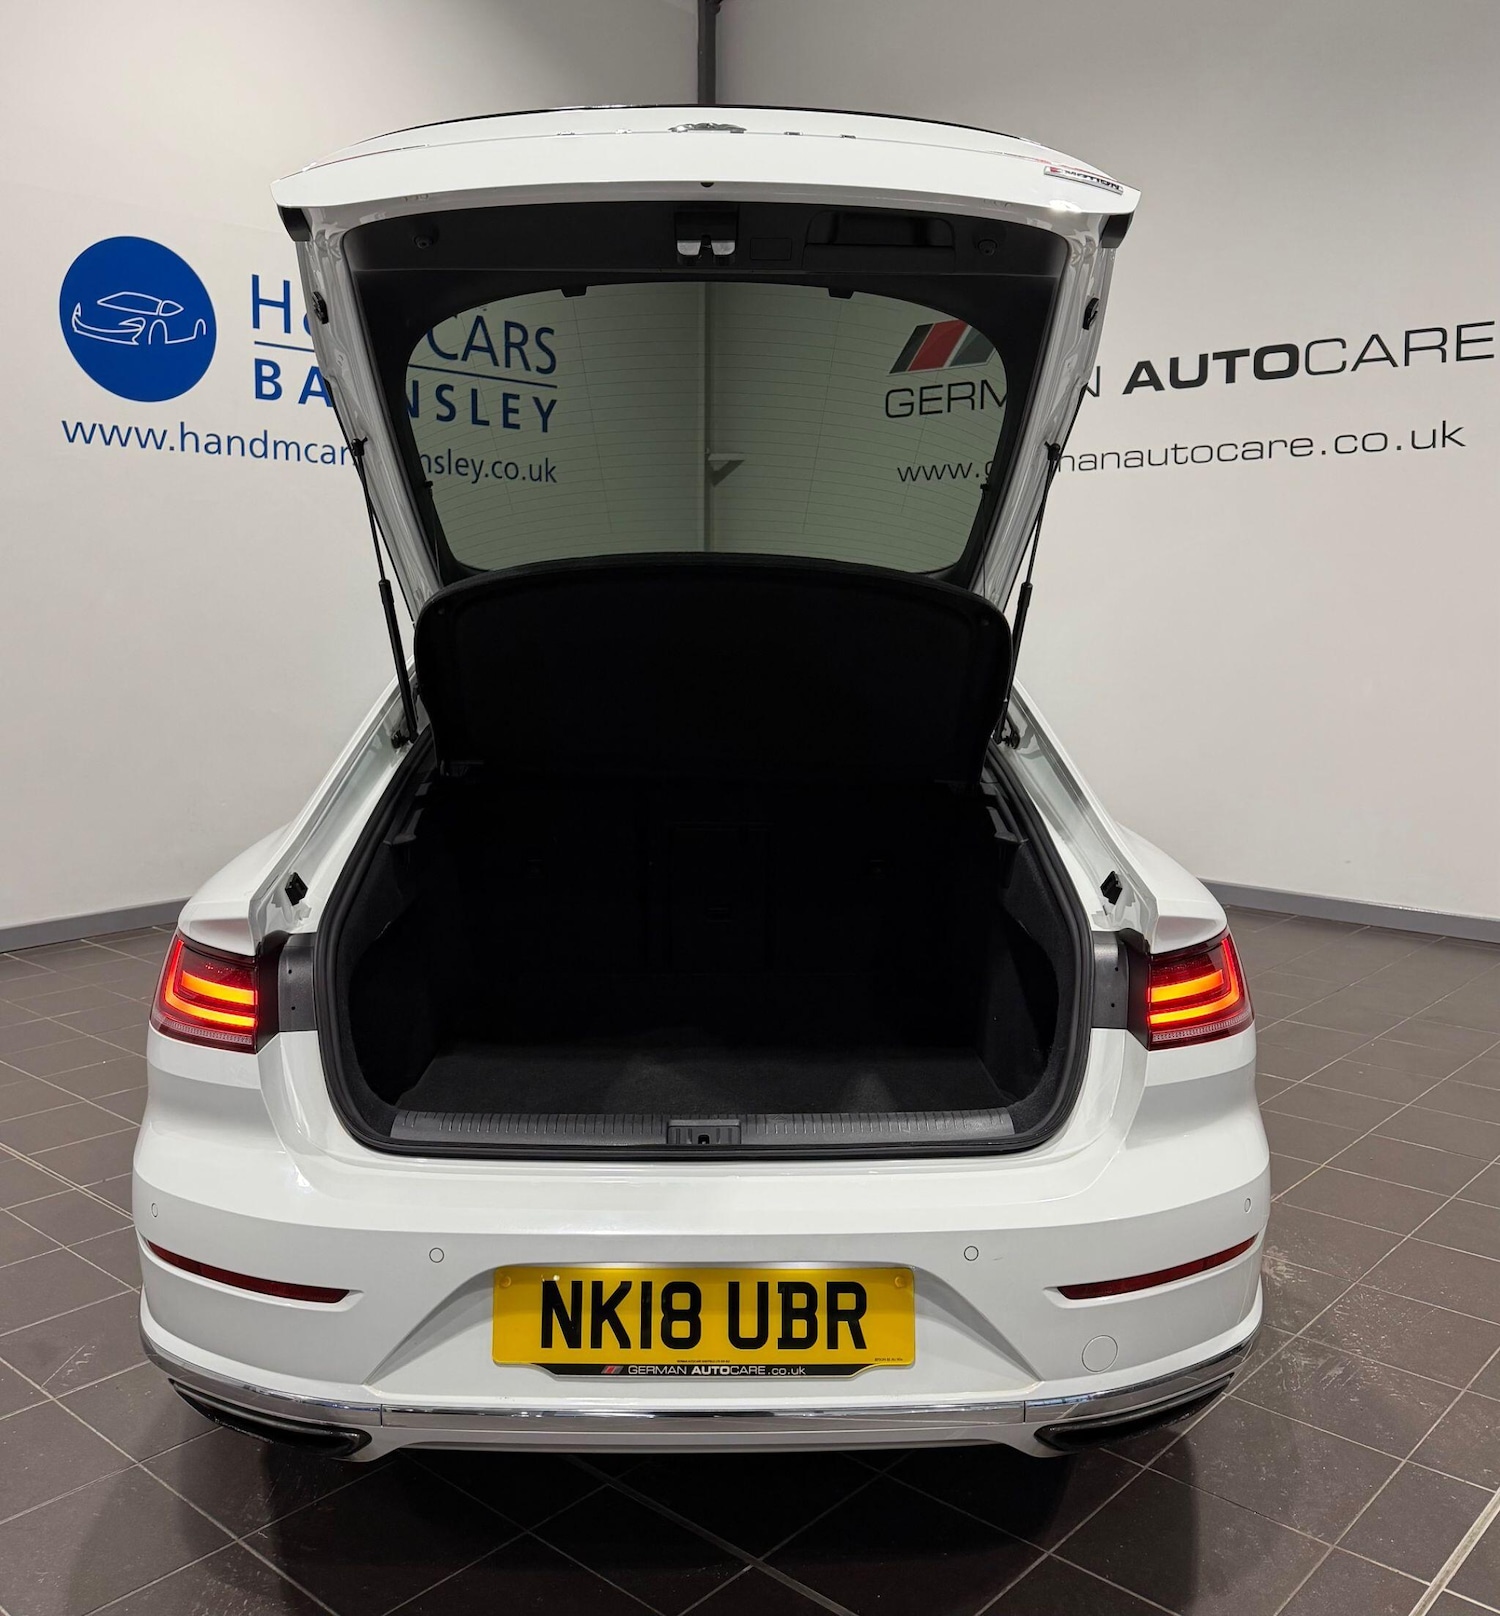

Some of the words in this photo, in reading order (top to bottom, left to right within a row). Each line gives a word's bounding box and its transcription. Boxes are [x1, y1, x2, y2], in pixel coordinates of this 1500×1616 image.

[426, 314, 557, 375] CARS
[1122, 320, 1496, 396] AUTOCARE
[254, 358, 558, 433] BASLEY
[541, 1280, 702, 1350] NK18
[727, 1280, 868, 1350] UBR
[627, 1364, 687, 1376] GERMAN
[690, 1364, 807, 1377] AUTOCARE.co.uk
